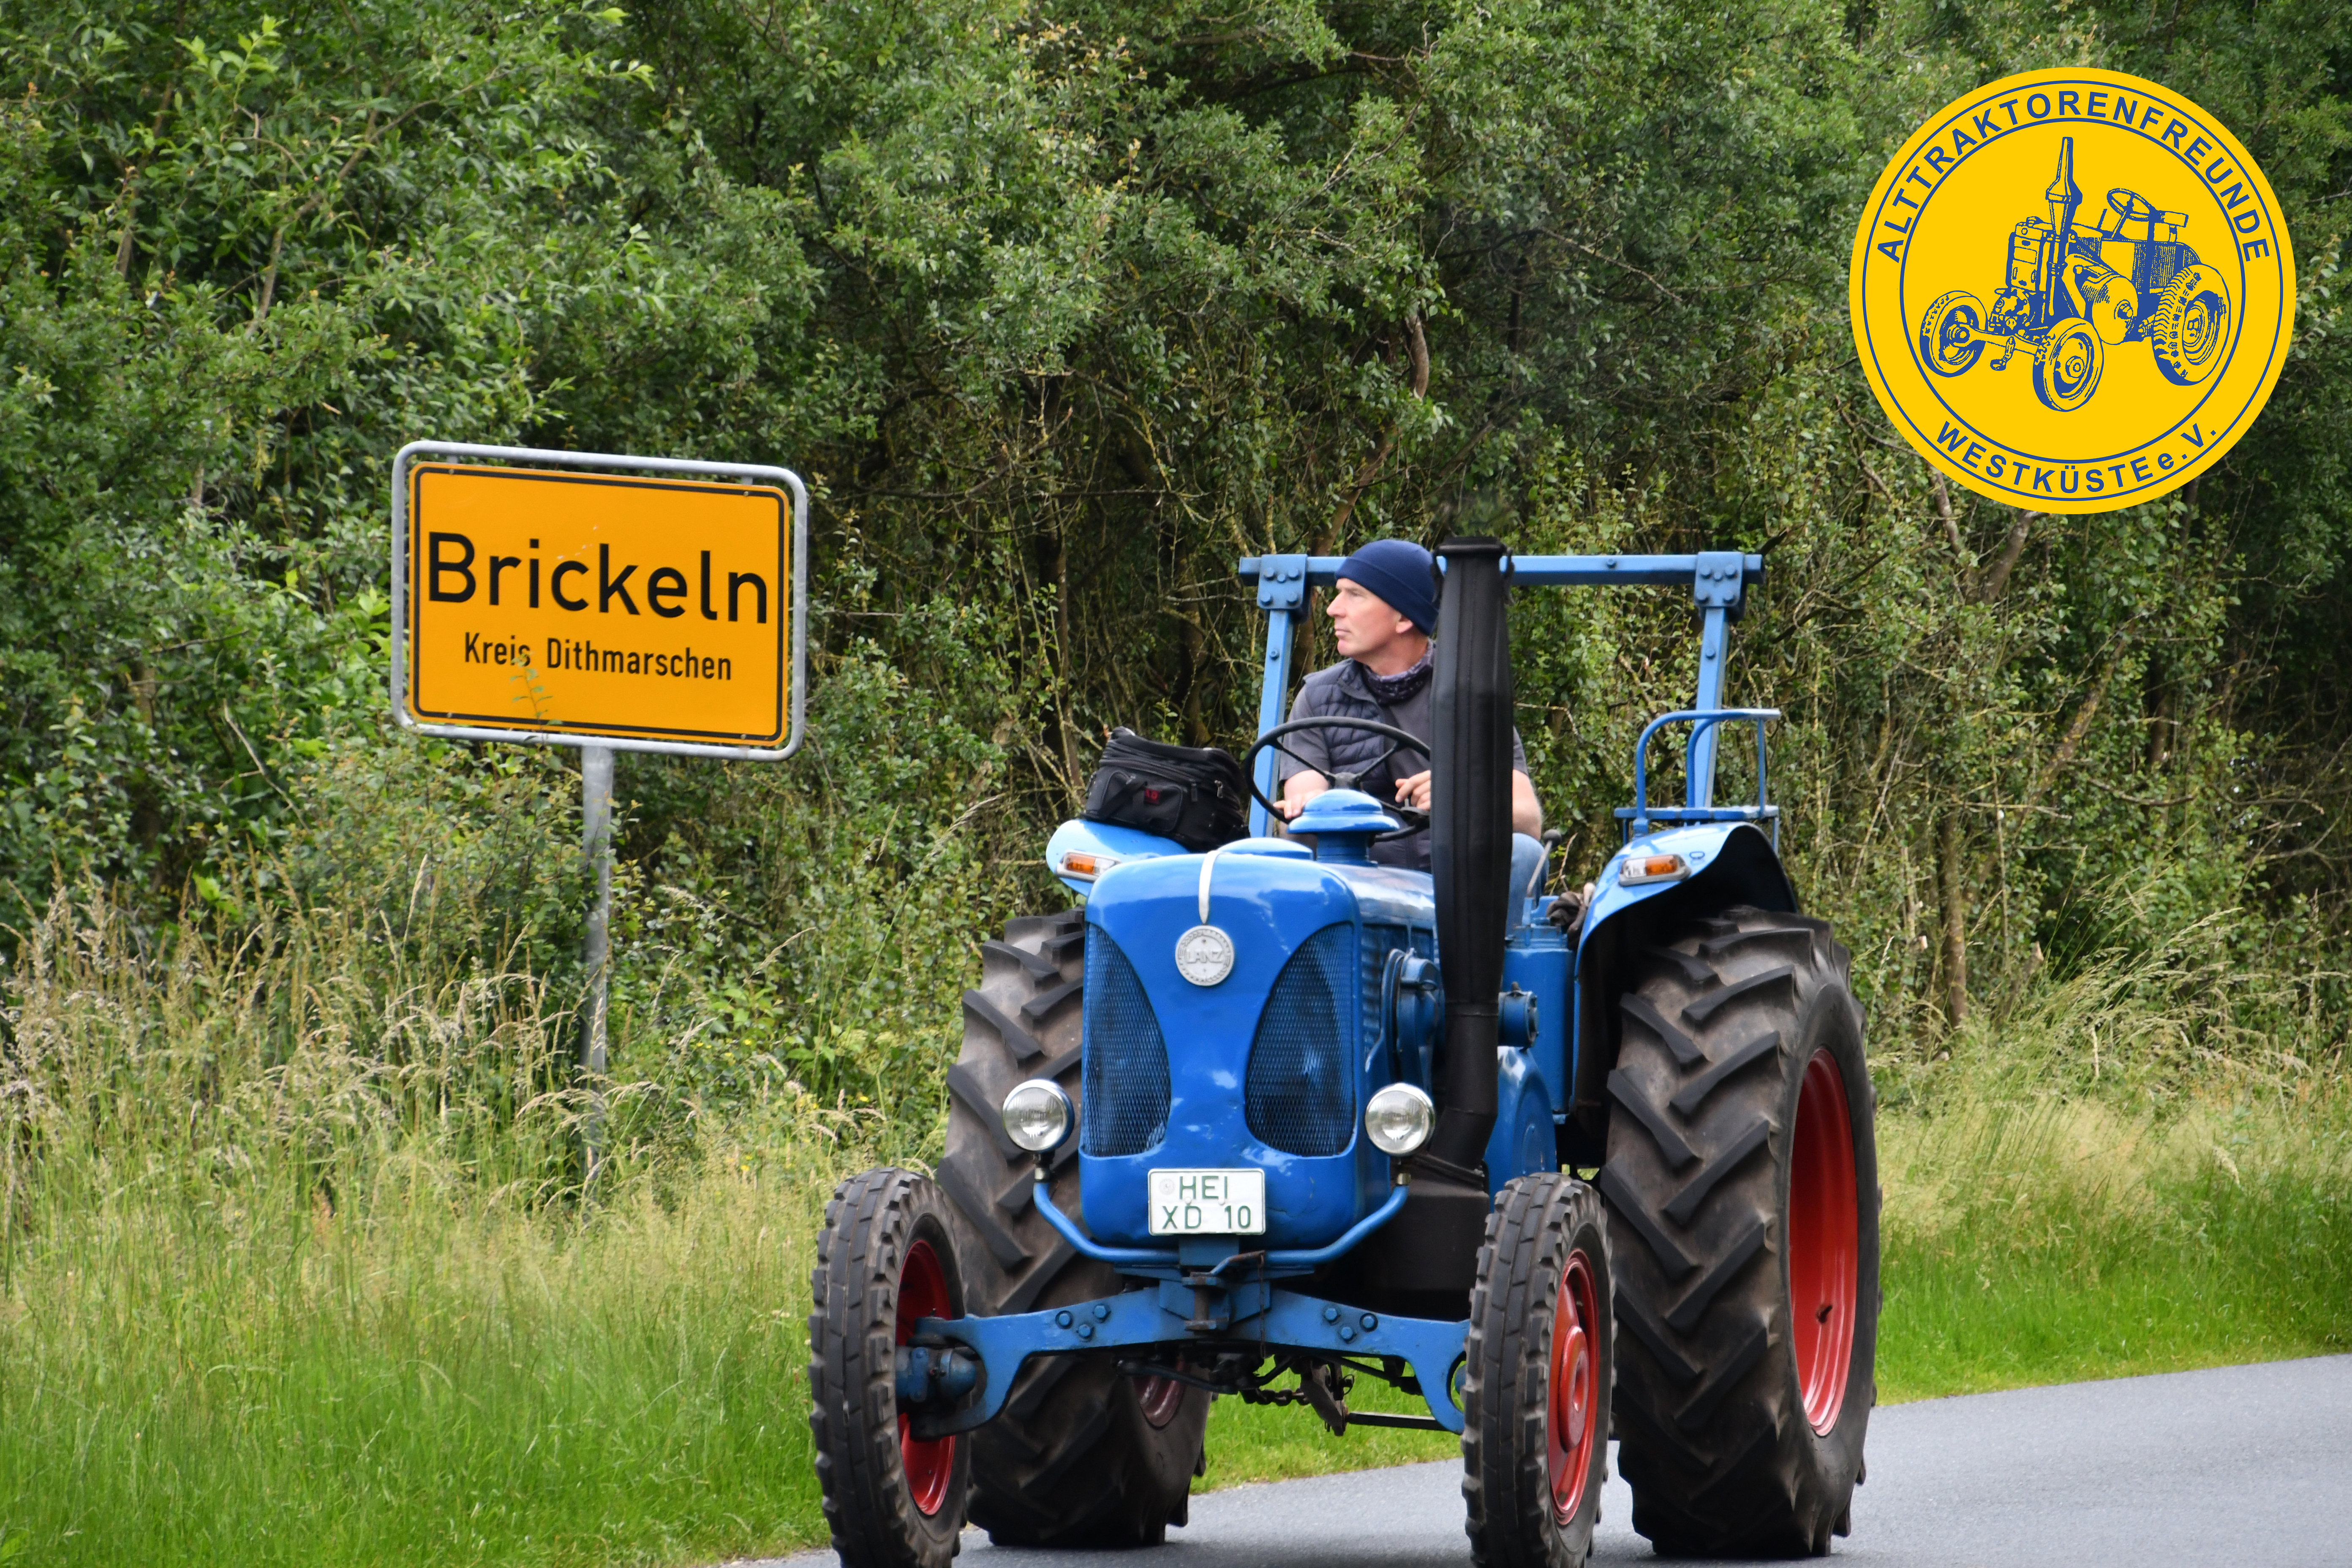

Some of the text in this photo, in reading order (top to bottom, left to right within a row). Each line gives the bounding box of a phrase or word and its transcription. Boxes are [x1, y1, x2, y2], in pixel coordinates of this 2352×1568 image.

[429, 532, 767, 623] Brickeln
[466, 632, 731, 680] Kreis Dithmarschen
[1186, 949, 1223, 964] LANZ
[1179, 1176, 1228, 1199] HEI
[1162, 1205, 1251, 1229] XD 10
